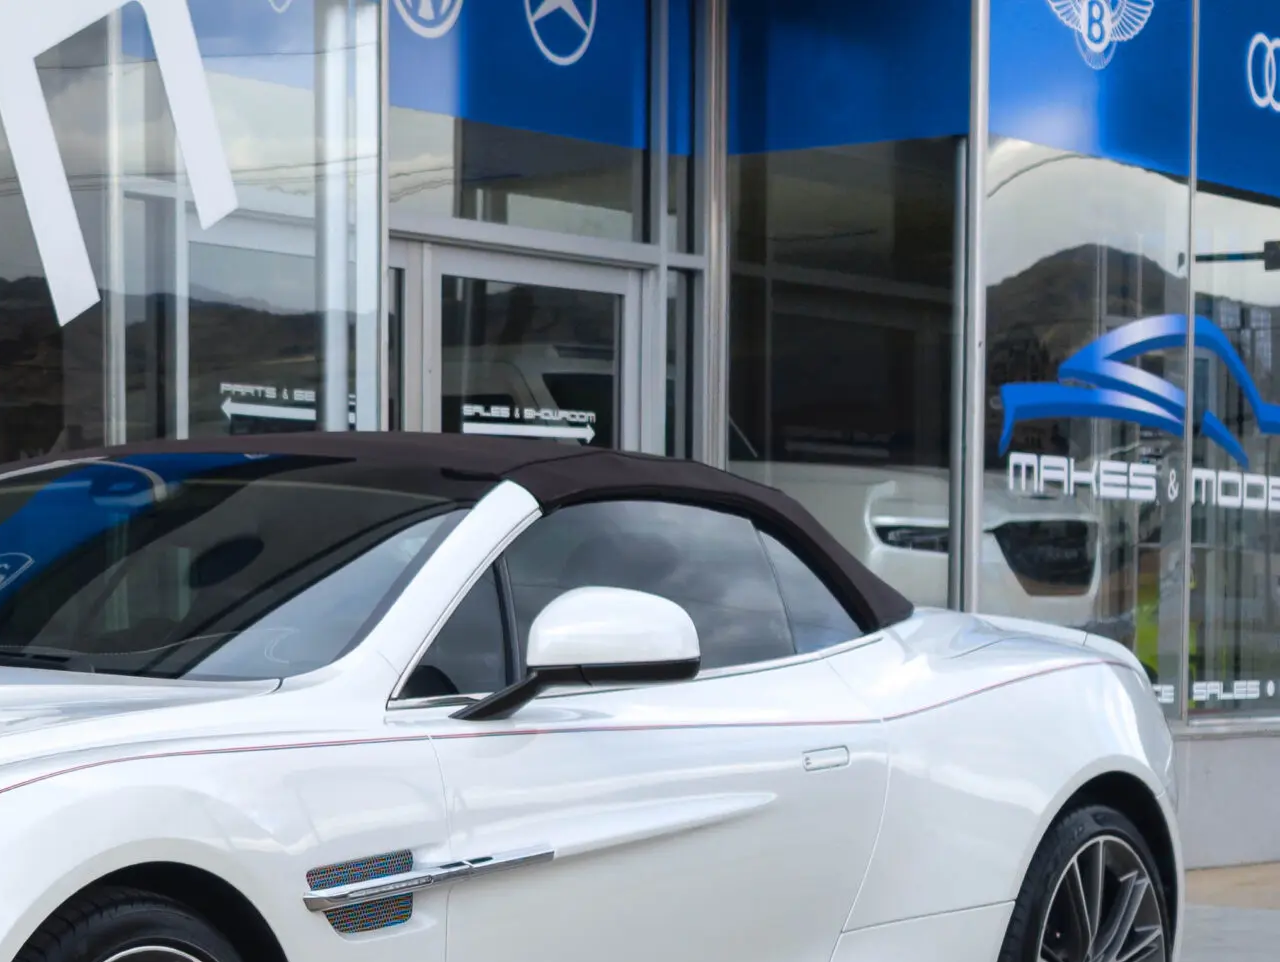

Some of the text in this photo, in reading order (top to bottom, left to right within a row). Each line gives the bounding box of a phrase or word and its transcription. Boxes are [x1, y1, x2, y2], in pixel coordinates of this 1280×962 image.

[220, 382, 277, 399] PARTS
[463, 404, 510, 418] SALES
[523, 408, 596, 424] SHOWROOM
[1009, 451, 1157, 501] MAKES
[1167, 468, 1180, 502] &
[1192, 680, 1260, 702] SALES
